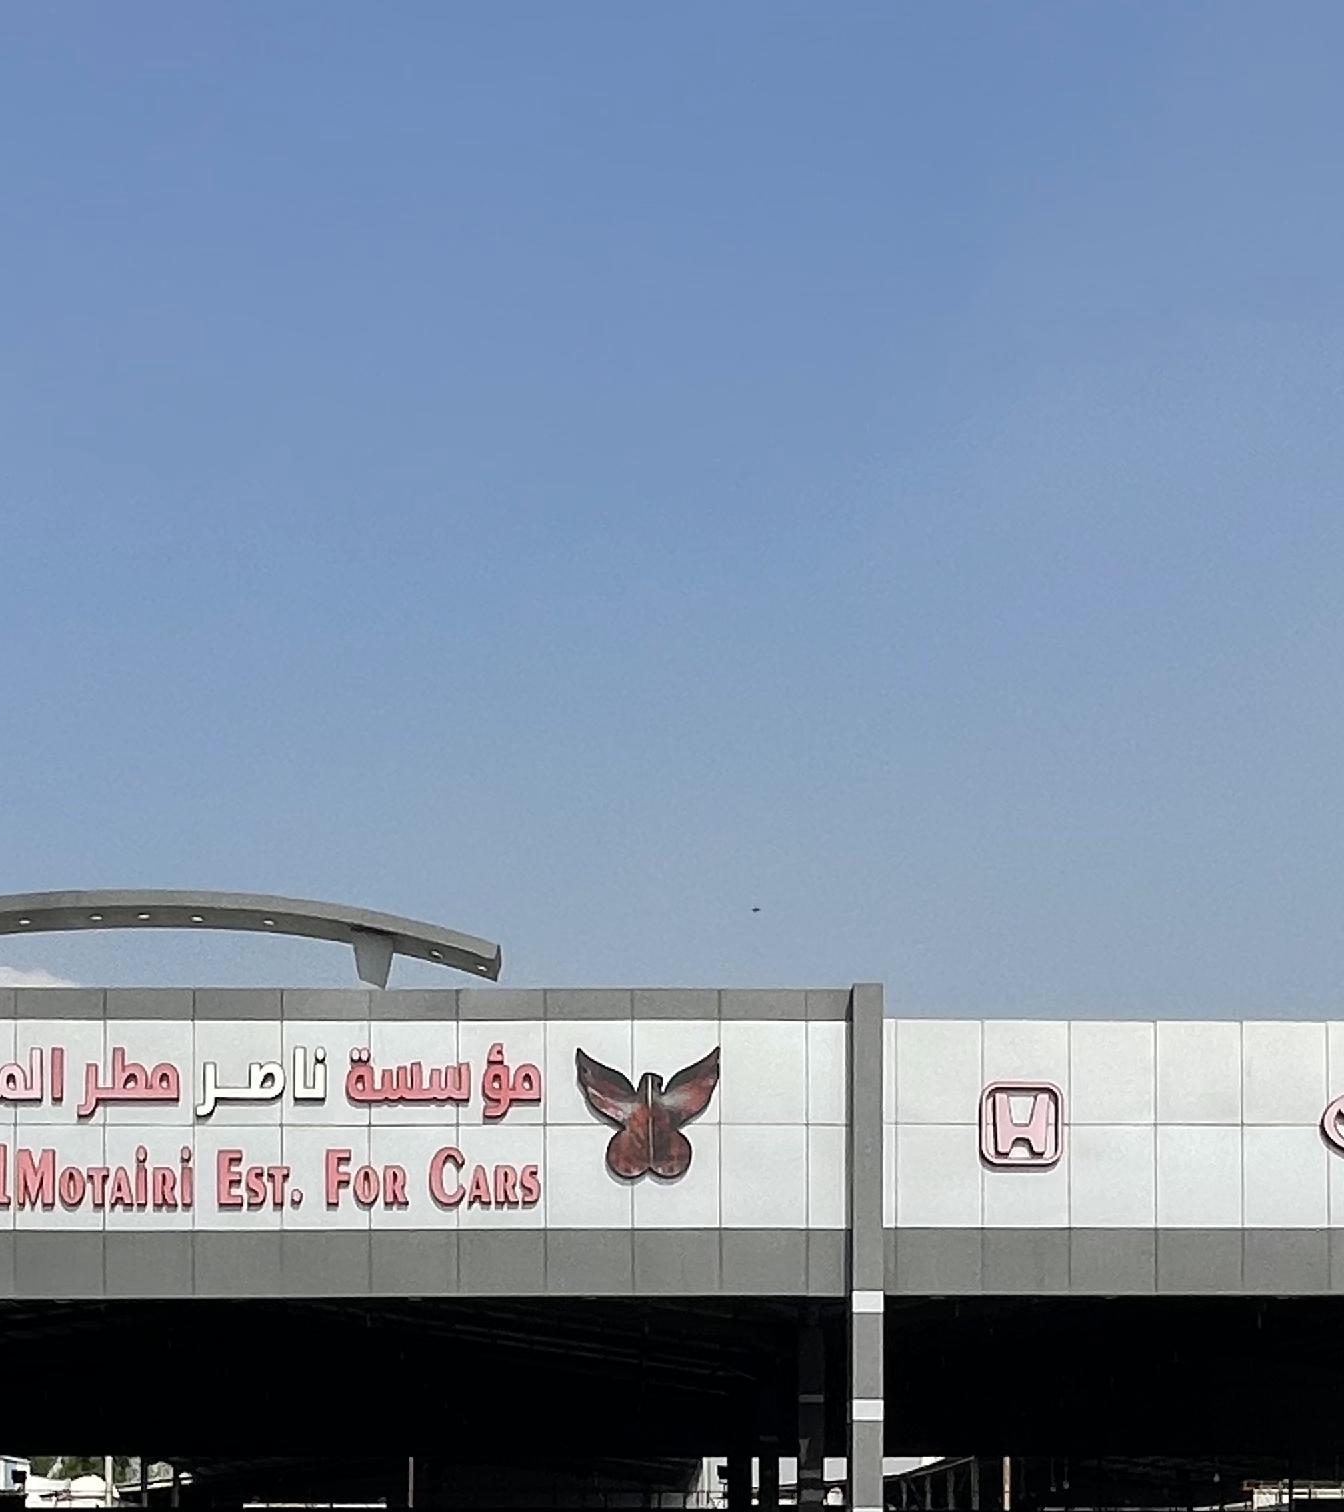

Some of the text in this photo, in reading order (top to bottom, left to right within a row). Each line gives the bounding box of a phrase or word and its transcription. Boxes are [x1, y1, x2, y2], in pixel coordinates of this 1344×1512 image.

[77, 1047, 180, 1118] مطر
[195, 1044, 328, 1117] ناصر
[345, 1042, 543, 1117] مؤسسة
[324, 1147, 410, 1207] FOR
[428, 1145, 542, 1207] CARS
